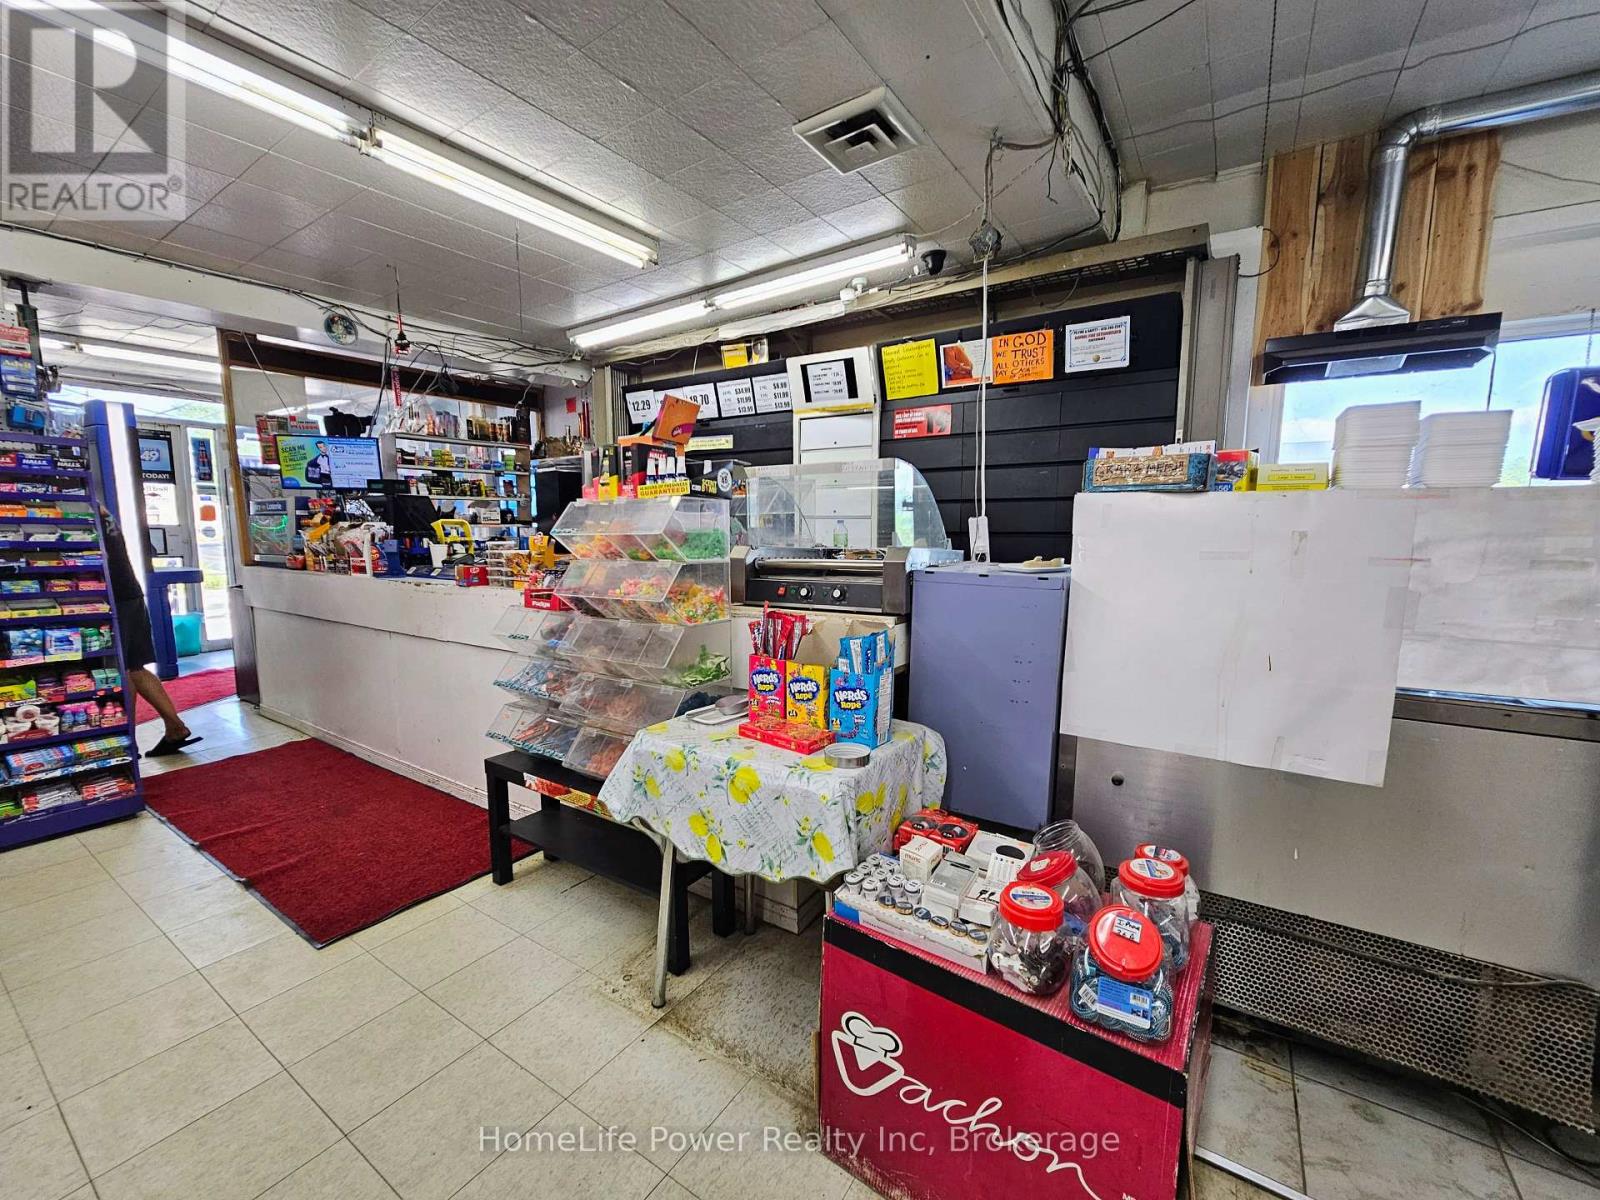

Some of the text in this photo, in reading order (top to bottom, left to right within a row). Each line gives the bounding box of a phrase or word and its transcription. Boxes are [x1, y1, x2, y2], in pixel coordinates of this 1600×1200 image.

[998, 332, 1047, 348] IN GOD
[1011, 346, 1047, 360] TRUST
[996, 358, 1045, 370] ALL OTHERS
[142, 472, 170, 480] TODAY!
[640, 486, 689, 497] GUARANTEED!
[840, 701, 862, 710] Rope
